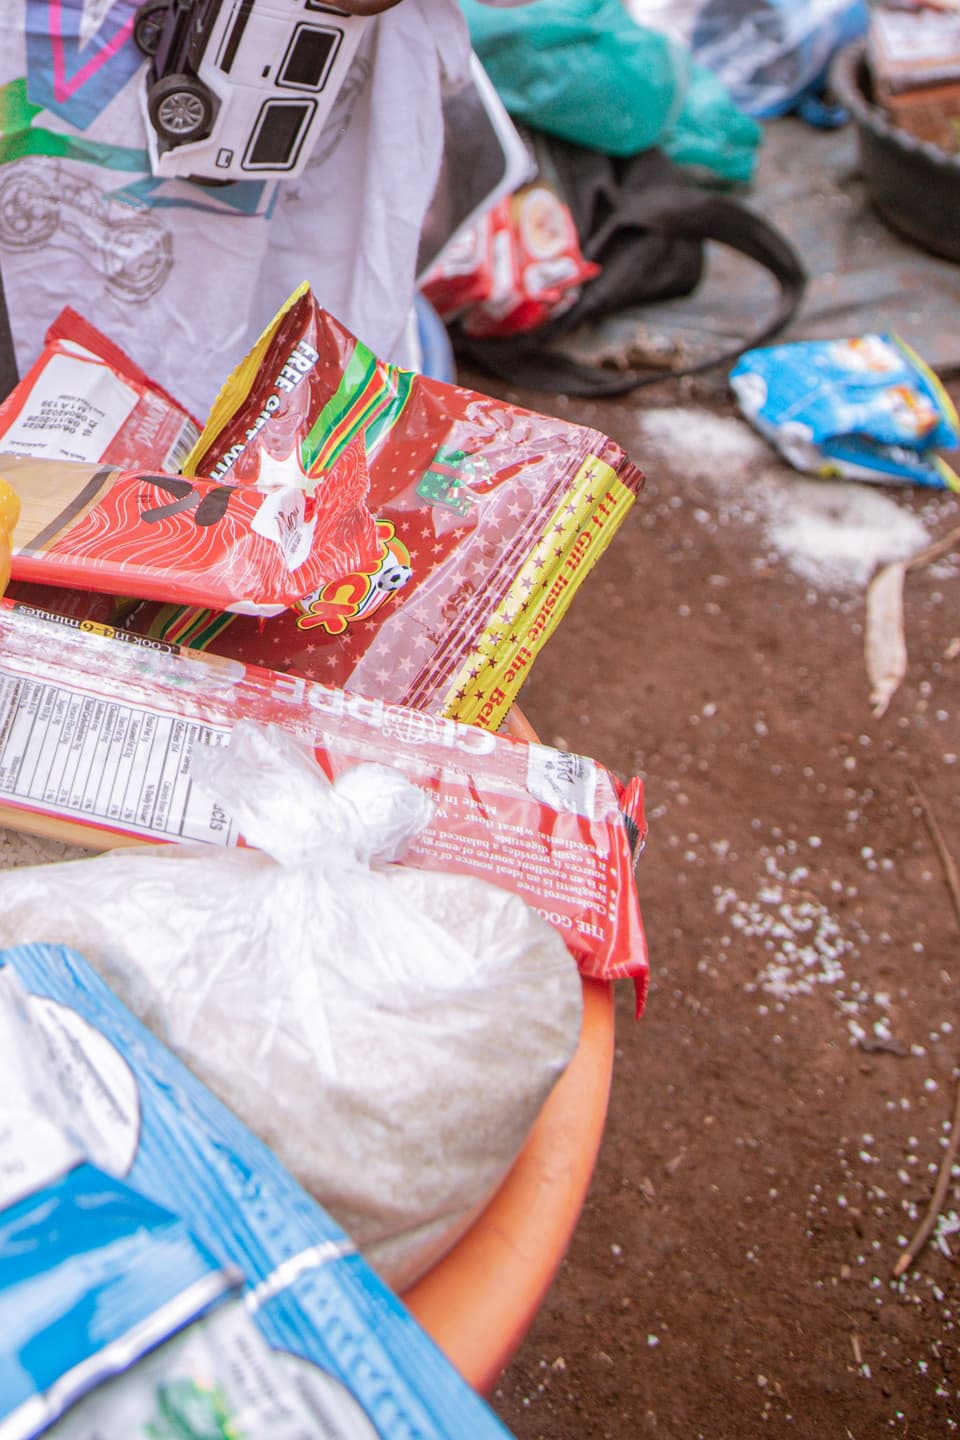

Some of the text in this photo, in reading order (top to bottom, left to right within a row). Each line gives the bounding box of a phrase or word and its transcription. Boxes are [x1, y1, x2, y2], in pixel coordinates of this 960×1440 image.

[278, 340, 320, 394] FREE
[567, 531, 594, 574] Gift
[16, 604, 79, 627] minutes
[527, 575, 571, 644] Inside
[114, 631, 129, 642] in
[132, 635, 172, 655] Cook
[504, 645, 532, 685] the
[530, 906, 607, 940] THE GOO
